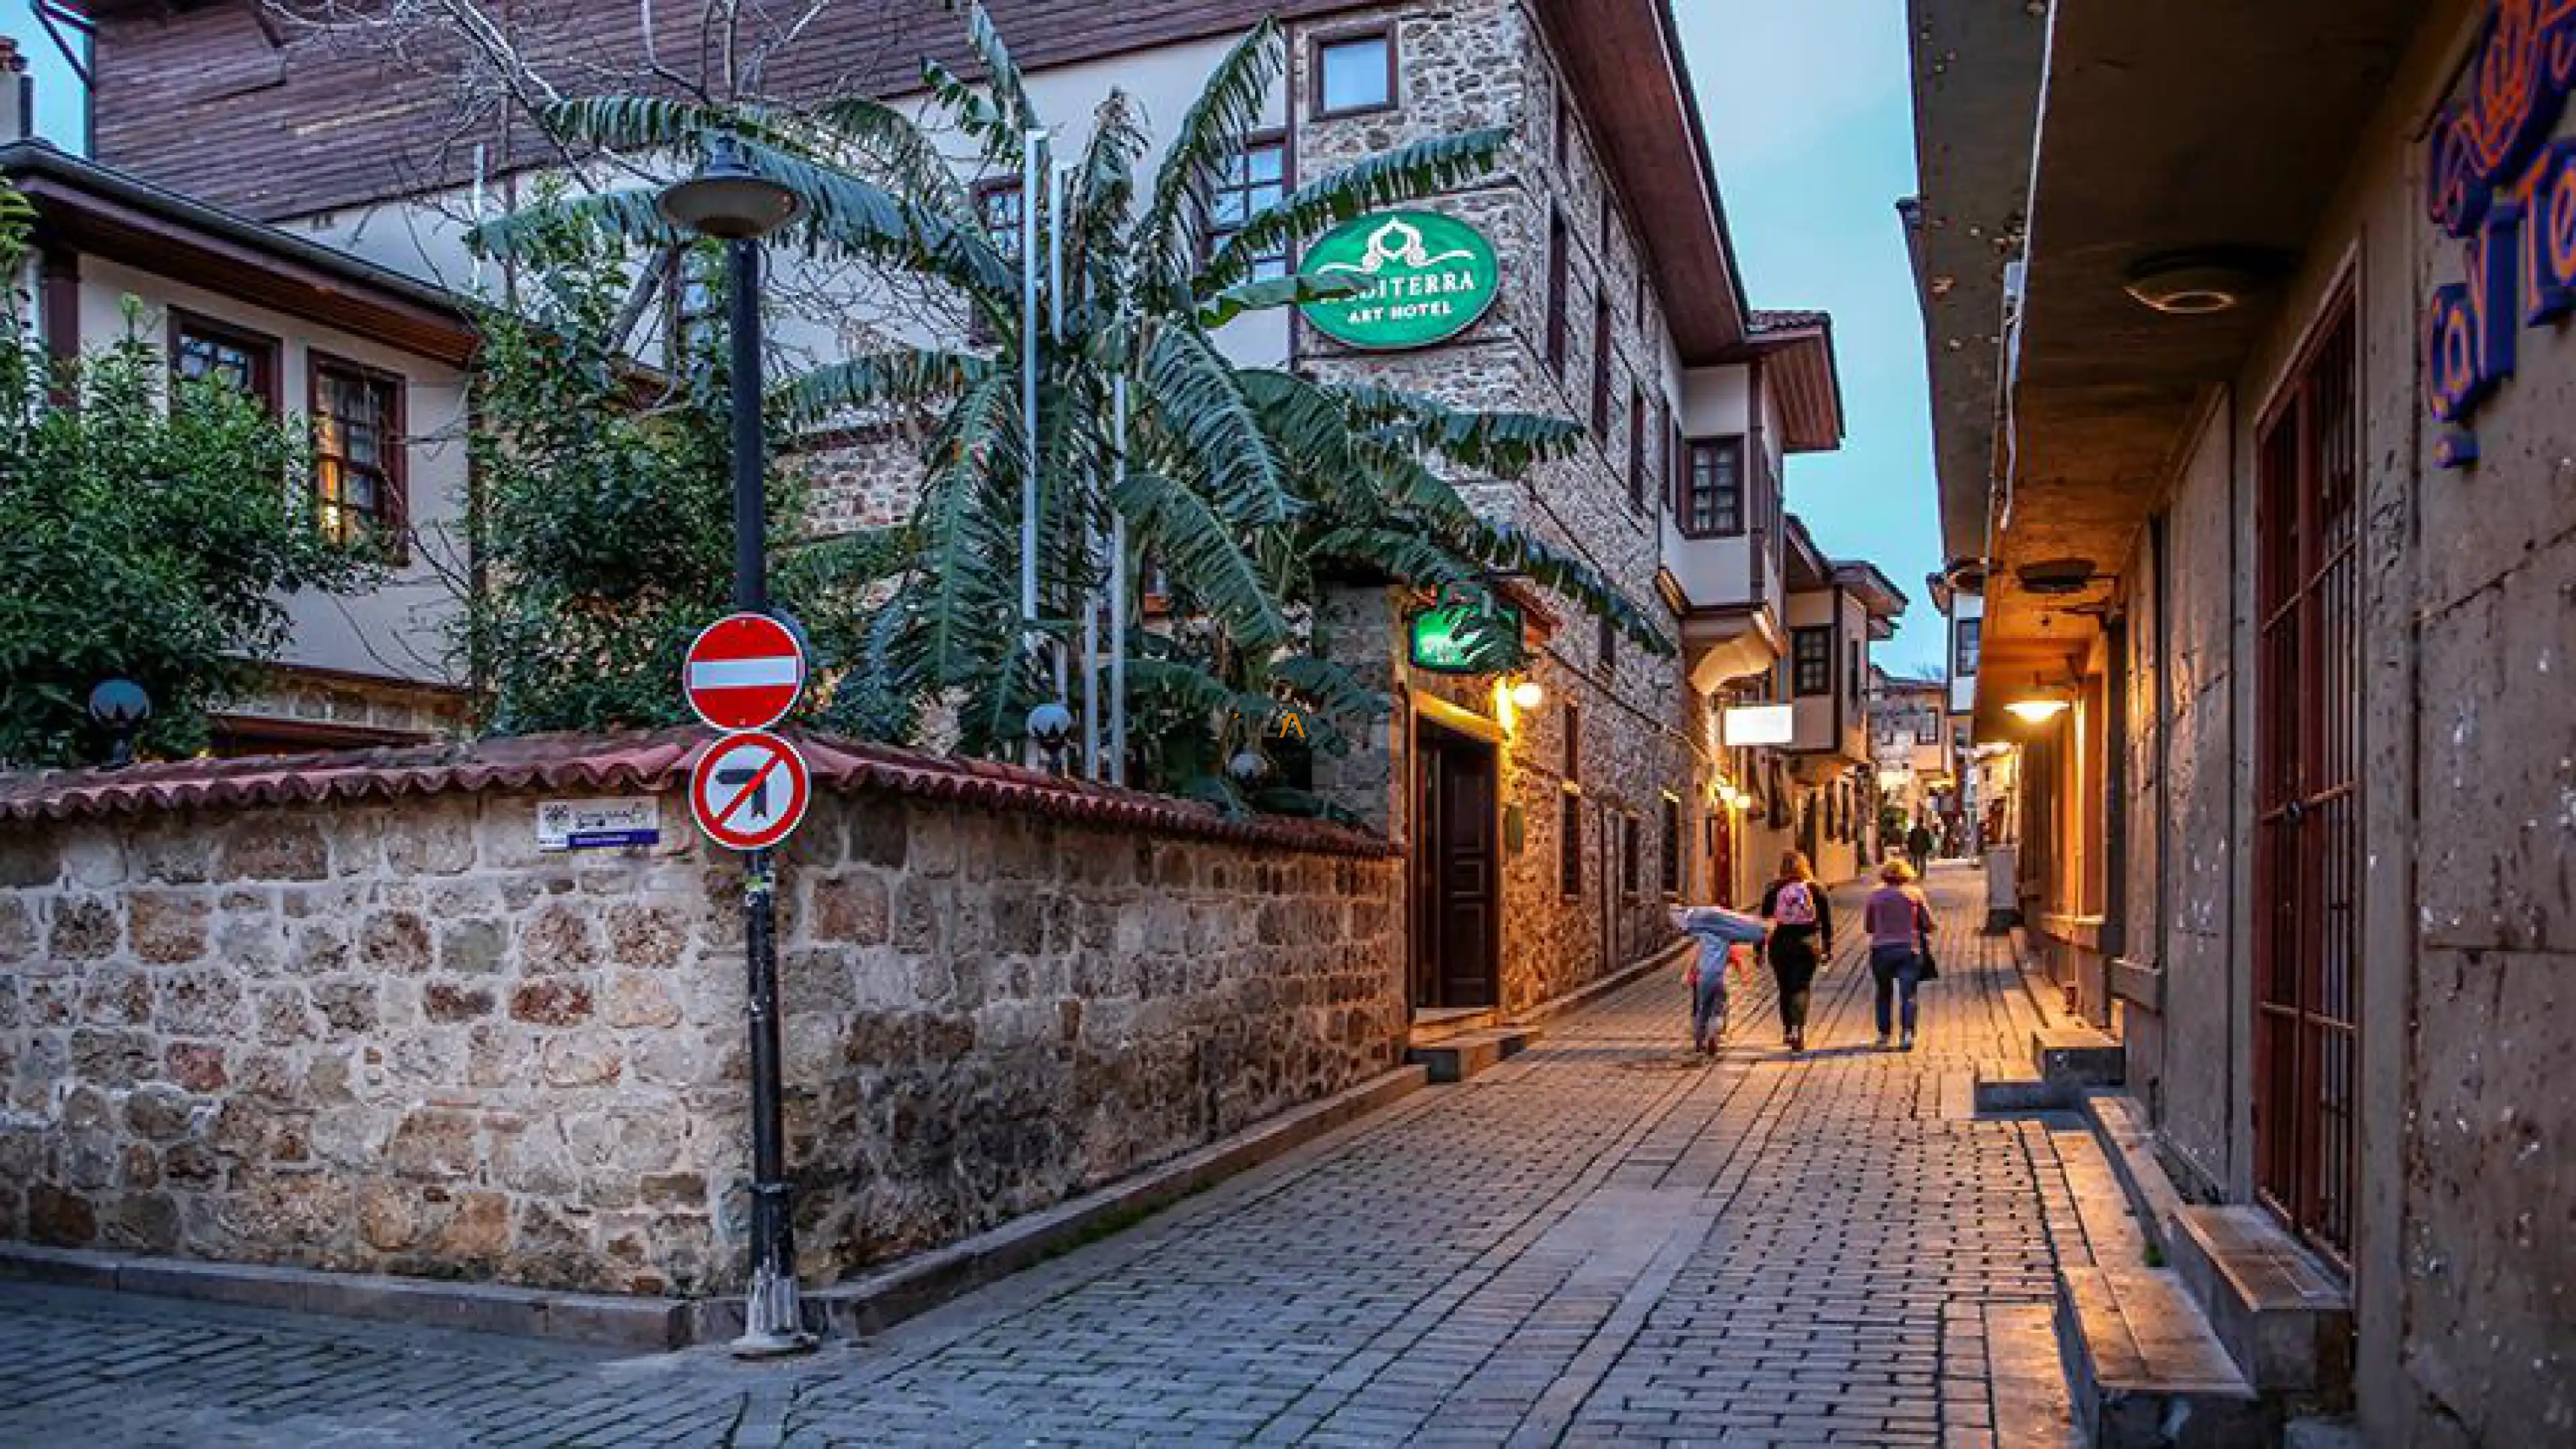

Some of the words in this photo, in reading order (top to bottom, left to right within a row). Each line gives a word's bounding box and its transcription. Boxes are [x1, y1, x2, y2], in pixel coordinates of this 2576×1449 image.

[1320, 270, 1475, 304] ITERRA
[1348, 307, 1383, 325] ART
[1389, 301, 1453, 319] HOTEL
